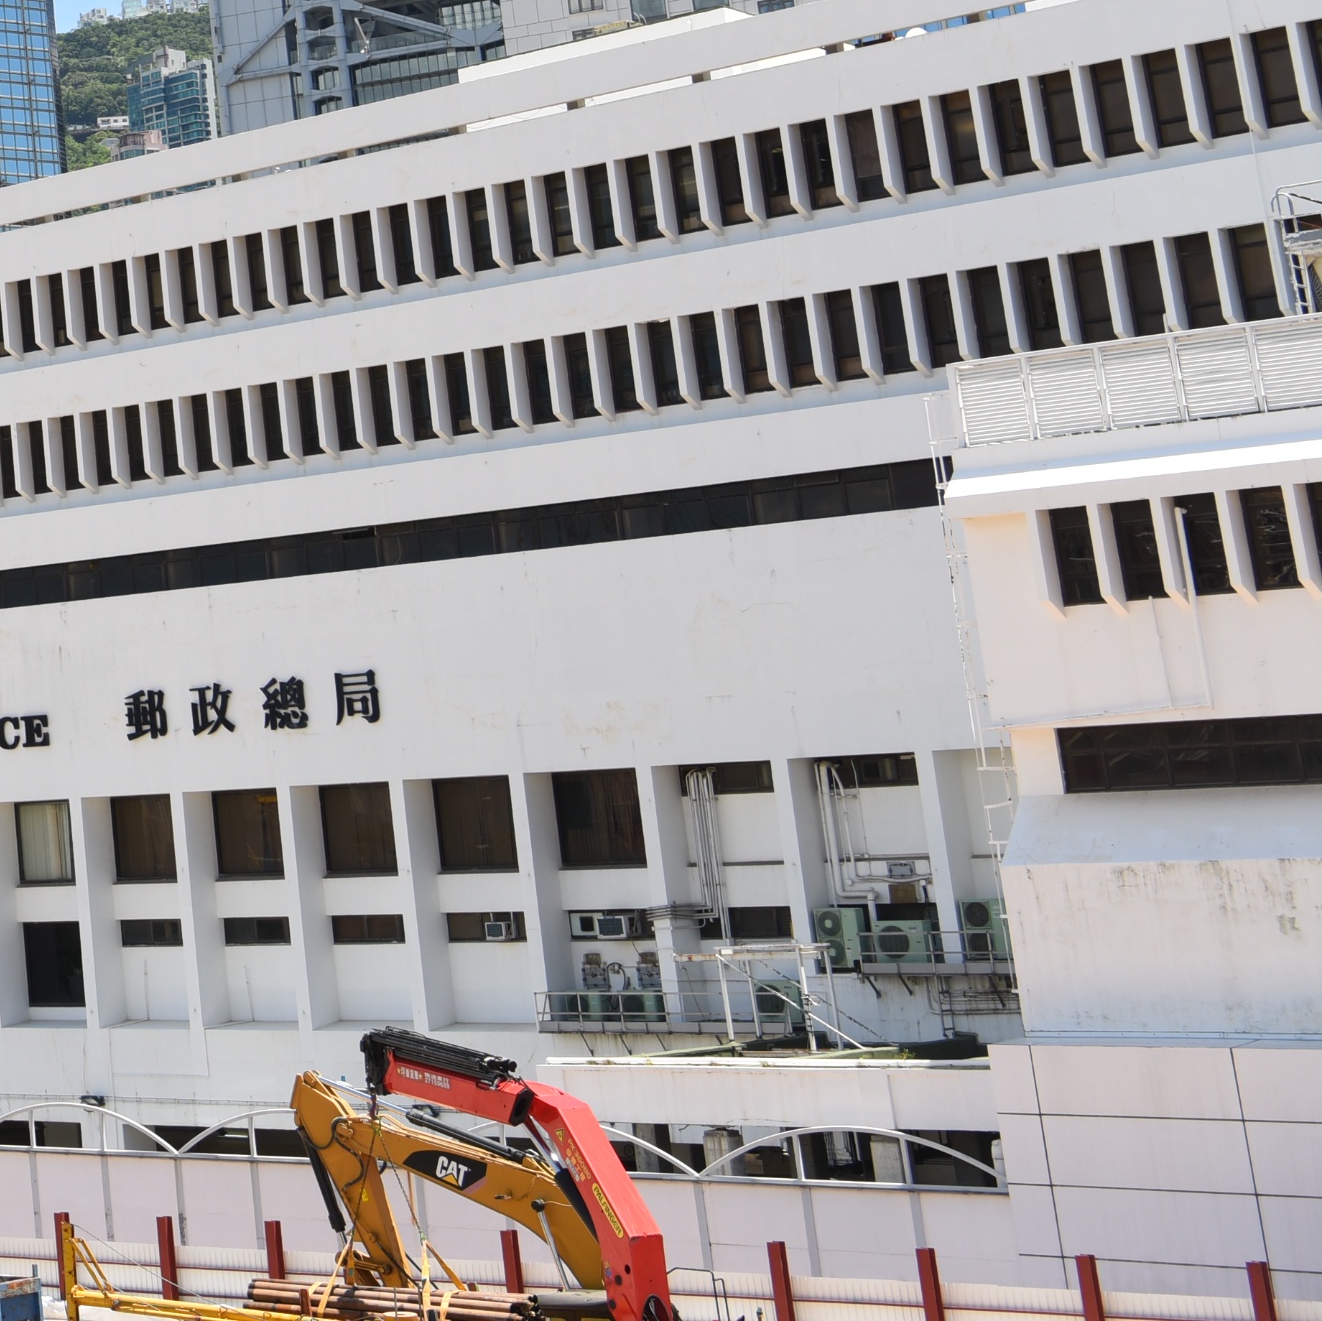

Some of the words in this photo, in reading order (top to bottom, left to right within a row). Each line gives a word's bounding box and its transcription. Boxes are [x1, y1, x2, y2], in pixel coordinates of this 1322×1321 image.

[125, 669, 380, 740] 郵政總局
[435, 1155, 468, 1187] CAT
[593, 1185, 622, 1236] PALFINGER
